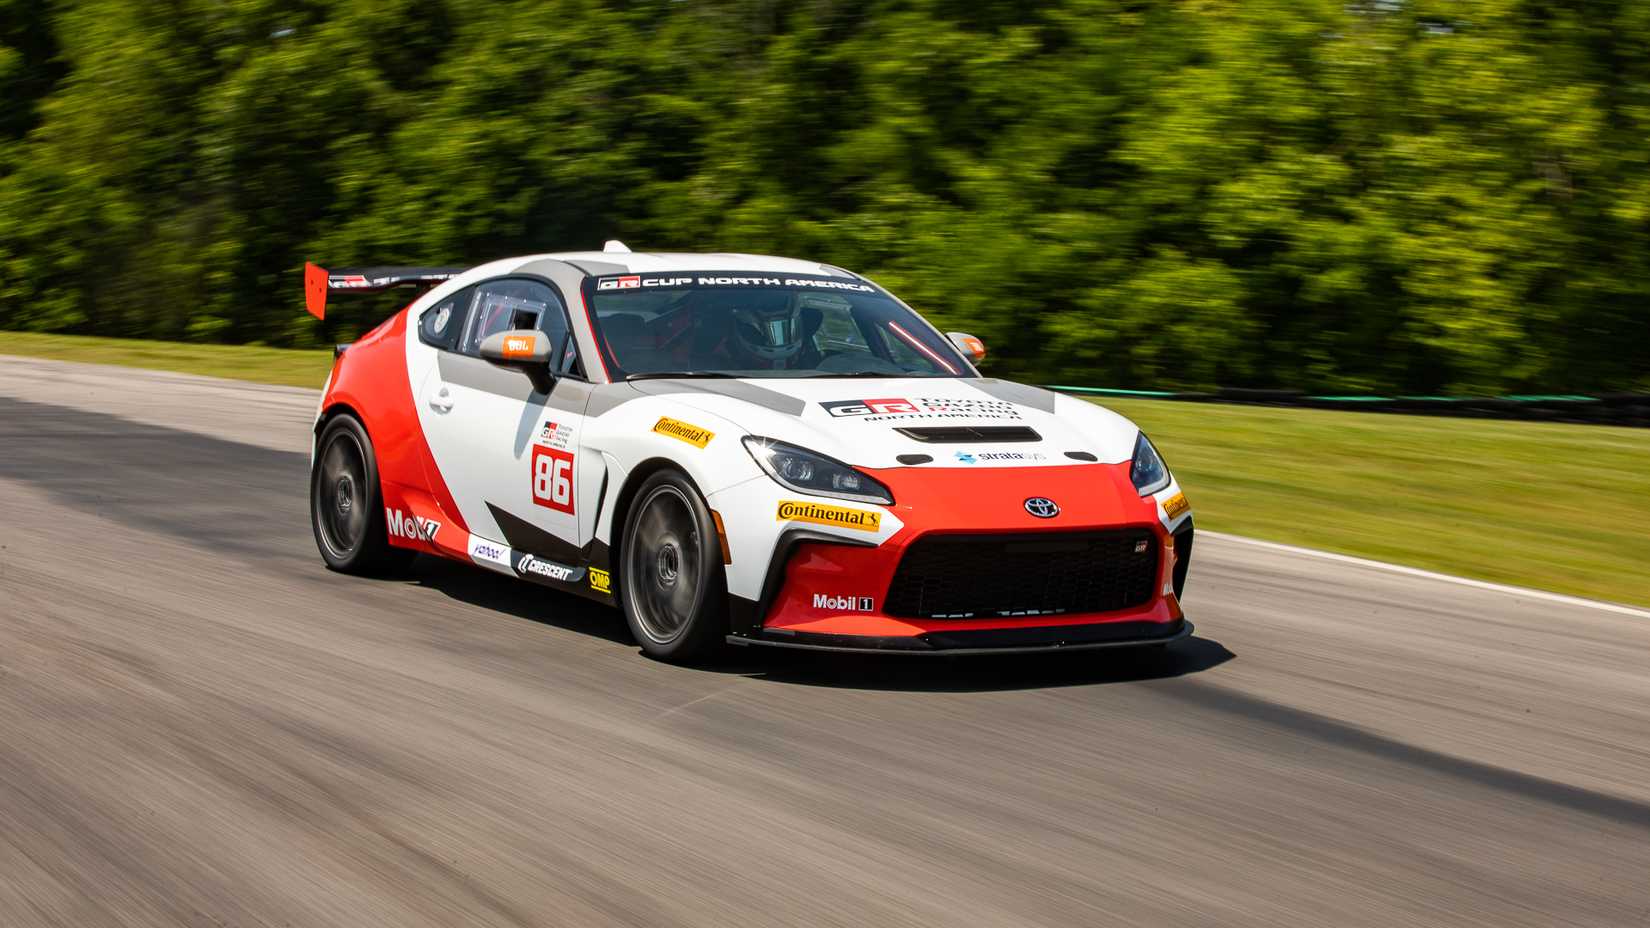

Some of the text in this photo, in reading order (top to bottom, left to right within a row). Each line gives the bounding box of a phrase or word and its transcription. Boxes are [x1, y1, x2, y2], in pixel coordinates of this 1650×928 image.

[598, 277, 875, 293] GR CUP NORTH AMERICA
[822, 401, 919, 416] GR
[864, 414, 932, 422] NORTH
[654, 418, 705, 441] Continental
[534, 453, 572, 506] 86
[778, 502, 865, 525] Continental
[528, 560, 573, 581] CRESCENT
[589, 571, 610, 589] OMP
[813, 594, 856, 611] Mobil
